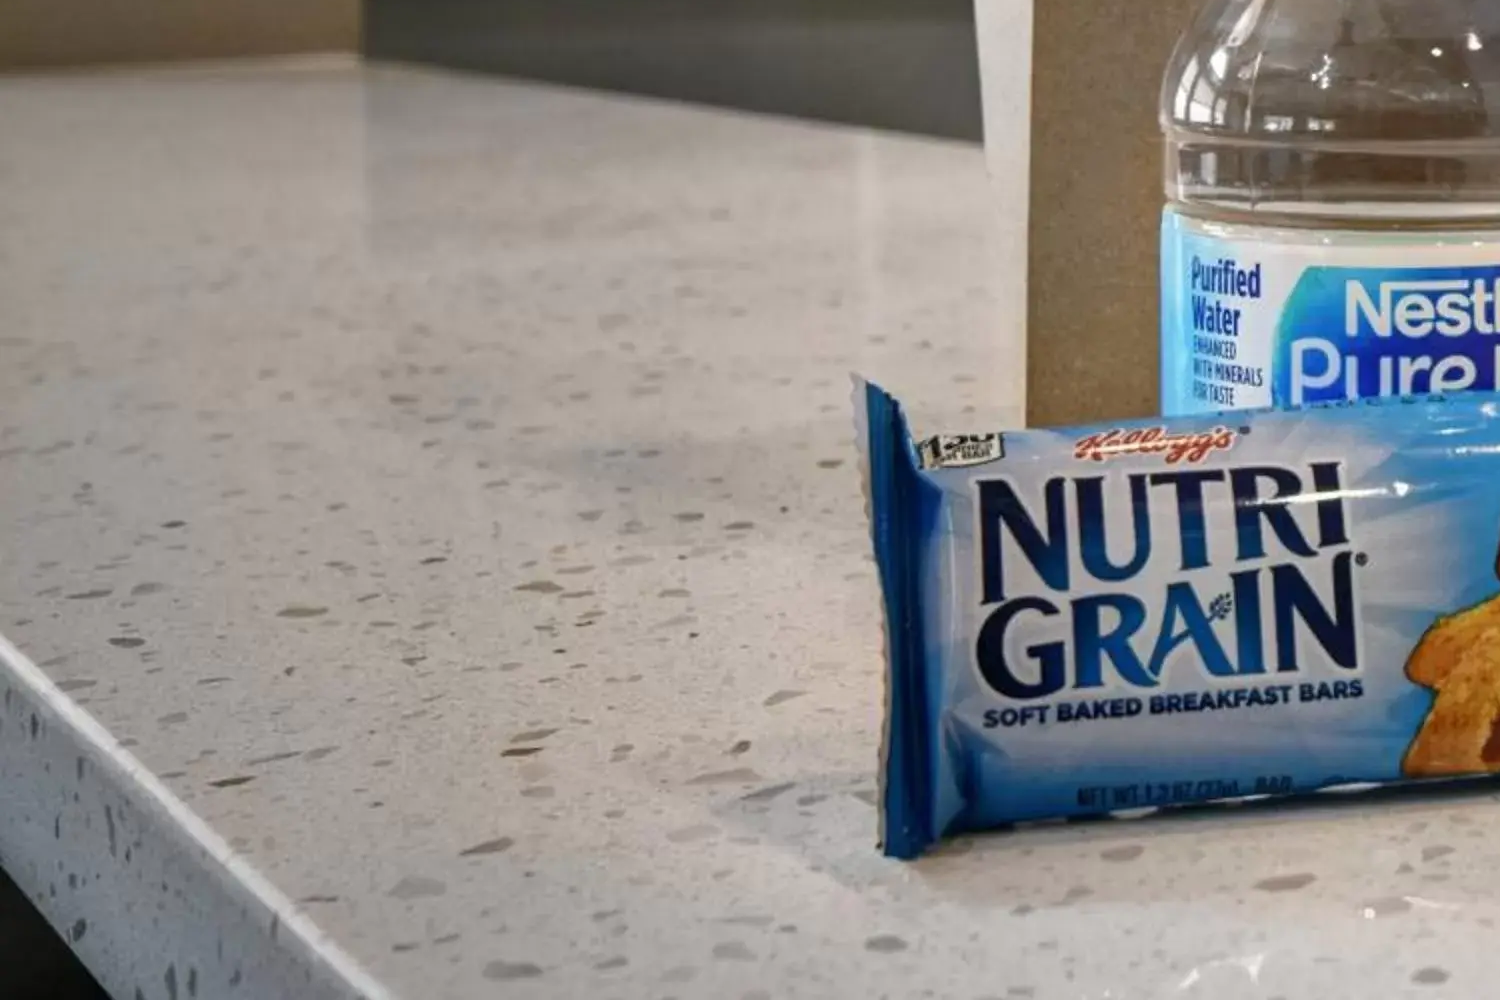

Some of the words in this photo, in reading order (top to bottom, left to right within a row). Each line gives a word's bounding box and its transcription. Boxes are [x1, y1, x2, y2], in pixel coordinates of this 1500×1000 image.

[1191, 255, 1262, 298] Purified
[1191, 295, 1241, 336] Water
[1193, 335, 1237, 361] ENHANCED
[1215, 362, 1263, 387] MINERALS
[1290, 337, 1476, 406] Pure
[1209, 384, 1235, 406] TASTE
[1074, 427, 1235, 464] Kellogg's
[976, 461, 1350, 606] NUTRI
[976, 550, 1359, 699] GRAIN
[983, 704, 1050, 729] SOFT
[1056, 697, 1142, 722] BAKED
[1149, 685, 1292, 715] BREAKFAST
[1299, 679, 1364, 702] BARS
